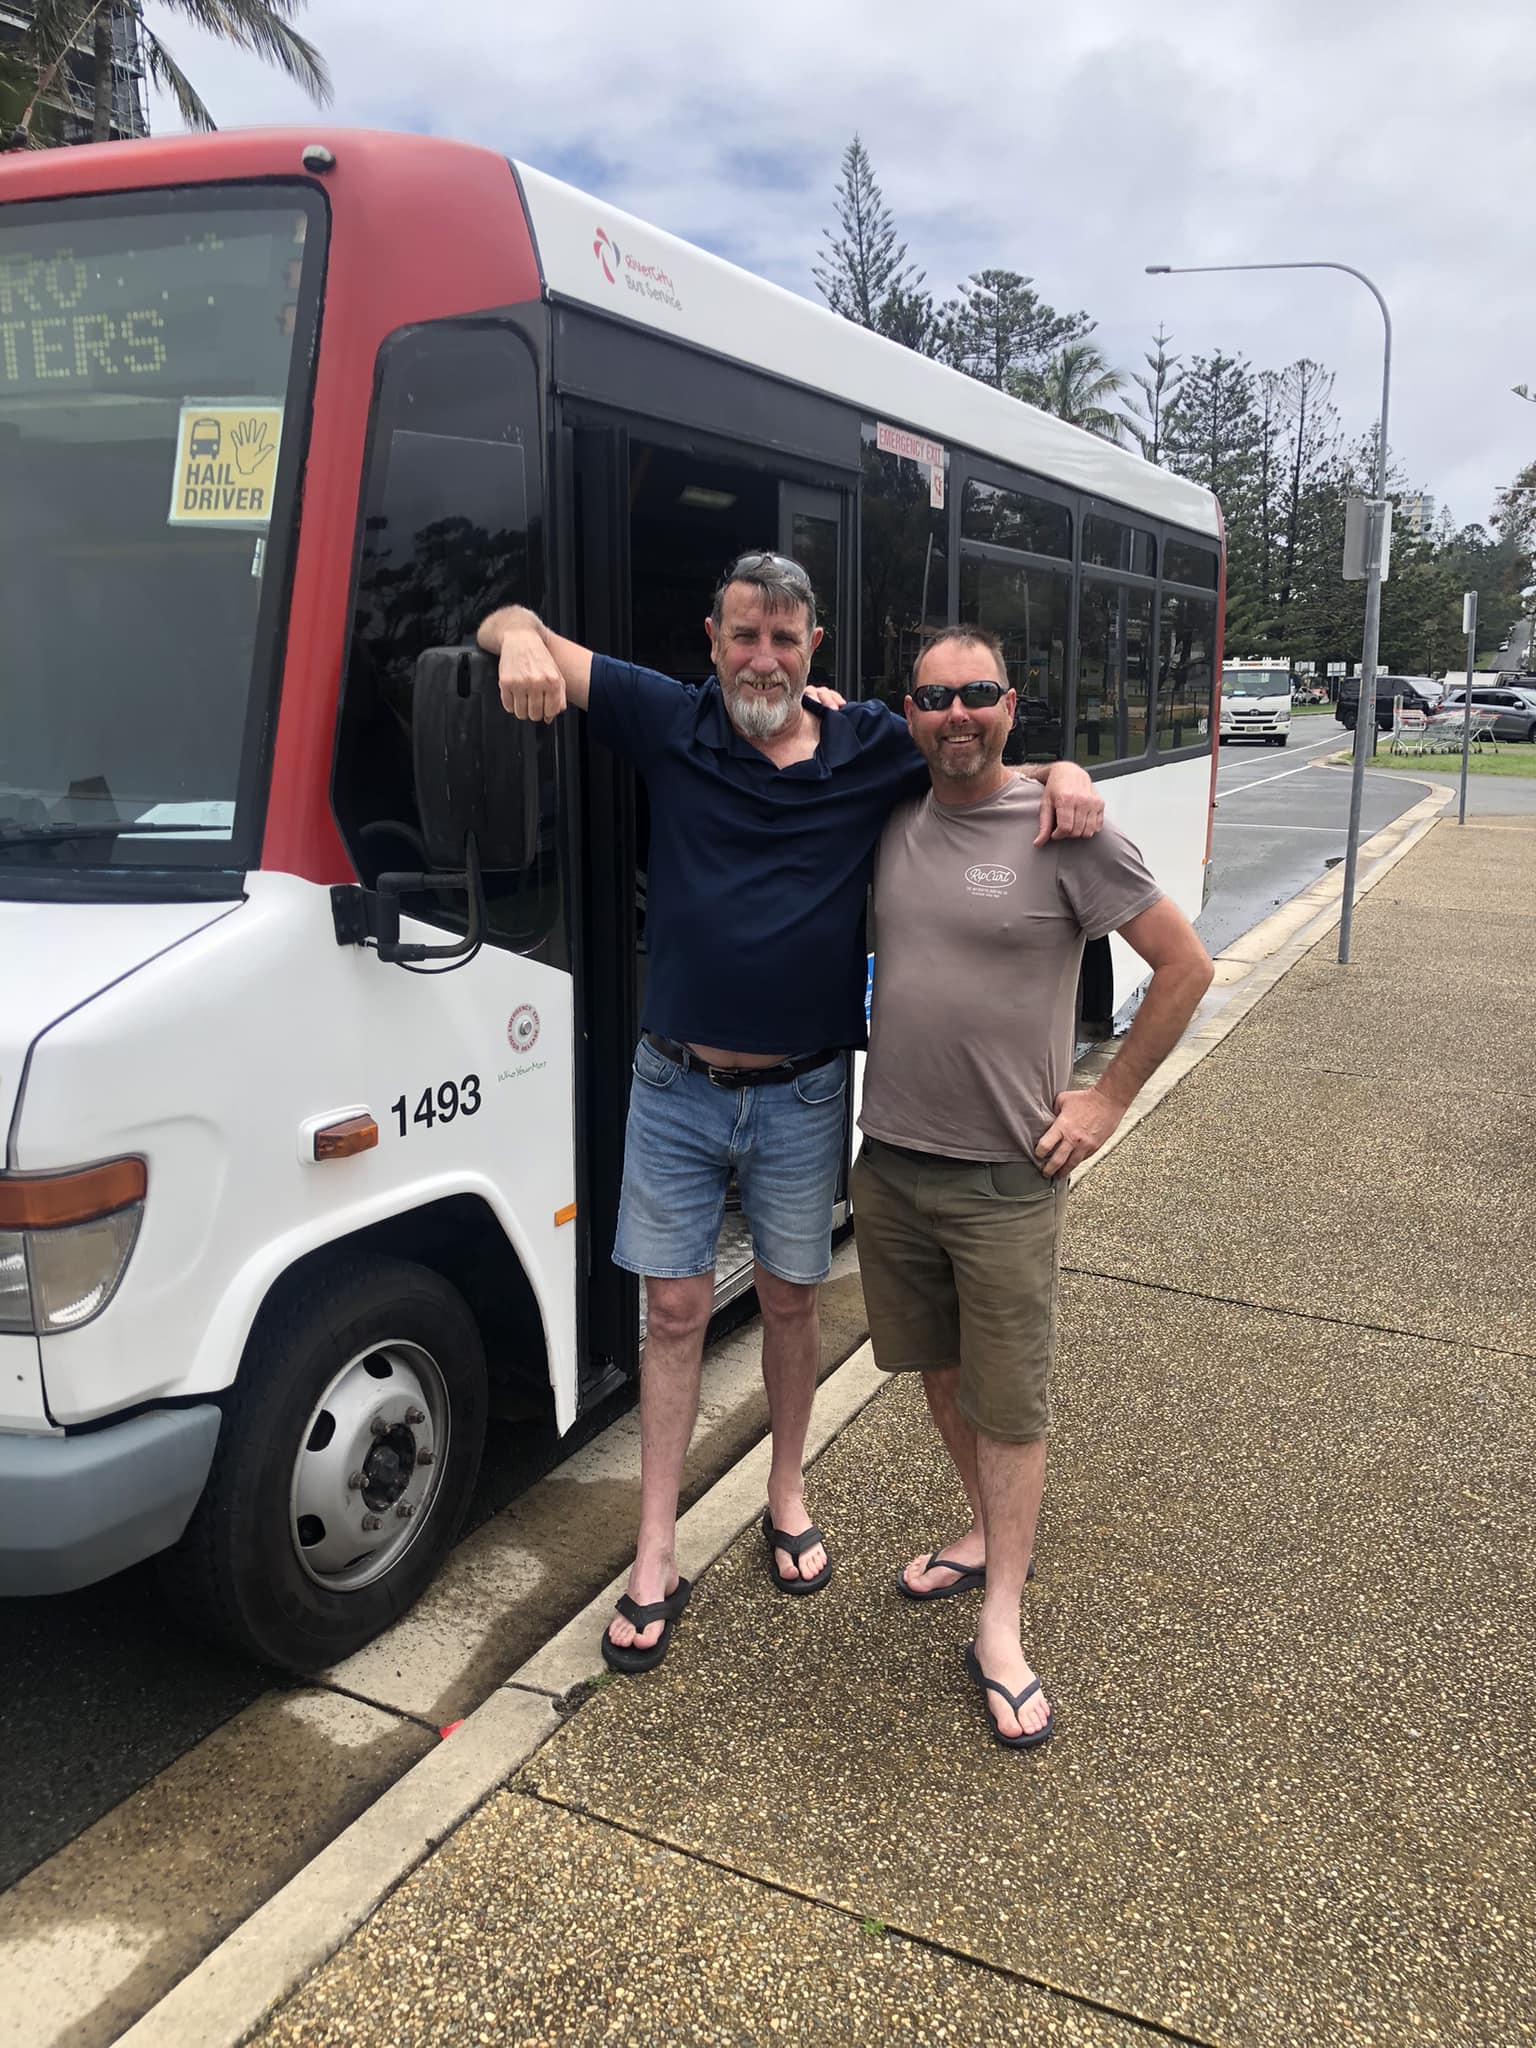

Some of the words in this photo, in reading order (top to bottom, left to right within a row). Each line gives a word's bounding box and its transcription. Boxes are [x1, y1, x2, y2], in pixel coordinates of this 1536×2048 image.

[624, 273, 646, 297] Bus
[645, 281, 683, 312] Service
[0, 309, 166, 380] TERS
[879, 427, 925, 458] EMERGENCY
[926, 444, 942, 466] EXIT
[186, 463, 235, 486] HAIL
[183, 488, 264, 511] DRIVER
[507, 1004, 532, 1033] EMERGENCY
[532, 1010, 540, 1025] EXIT
[521, 1029, 539, 1052] RELEASE
[391, 1073, 482, 1138] 1493
